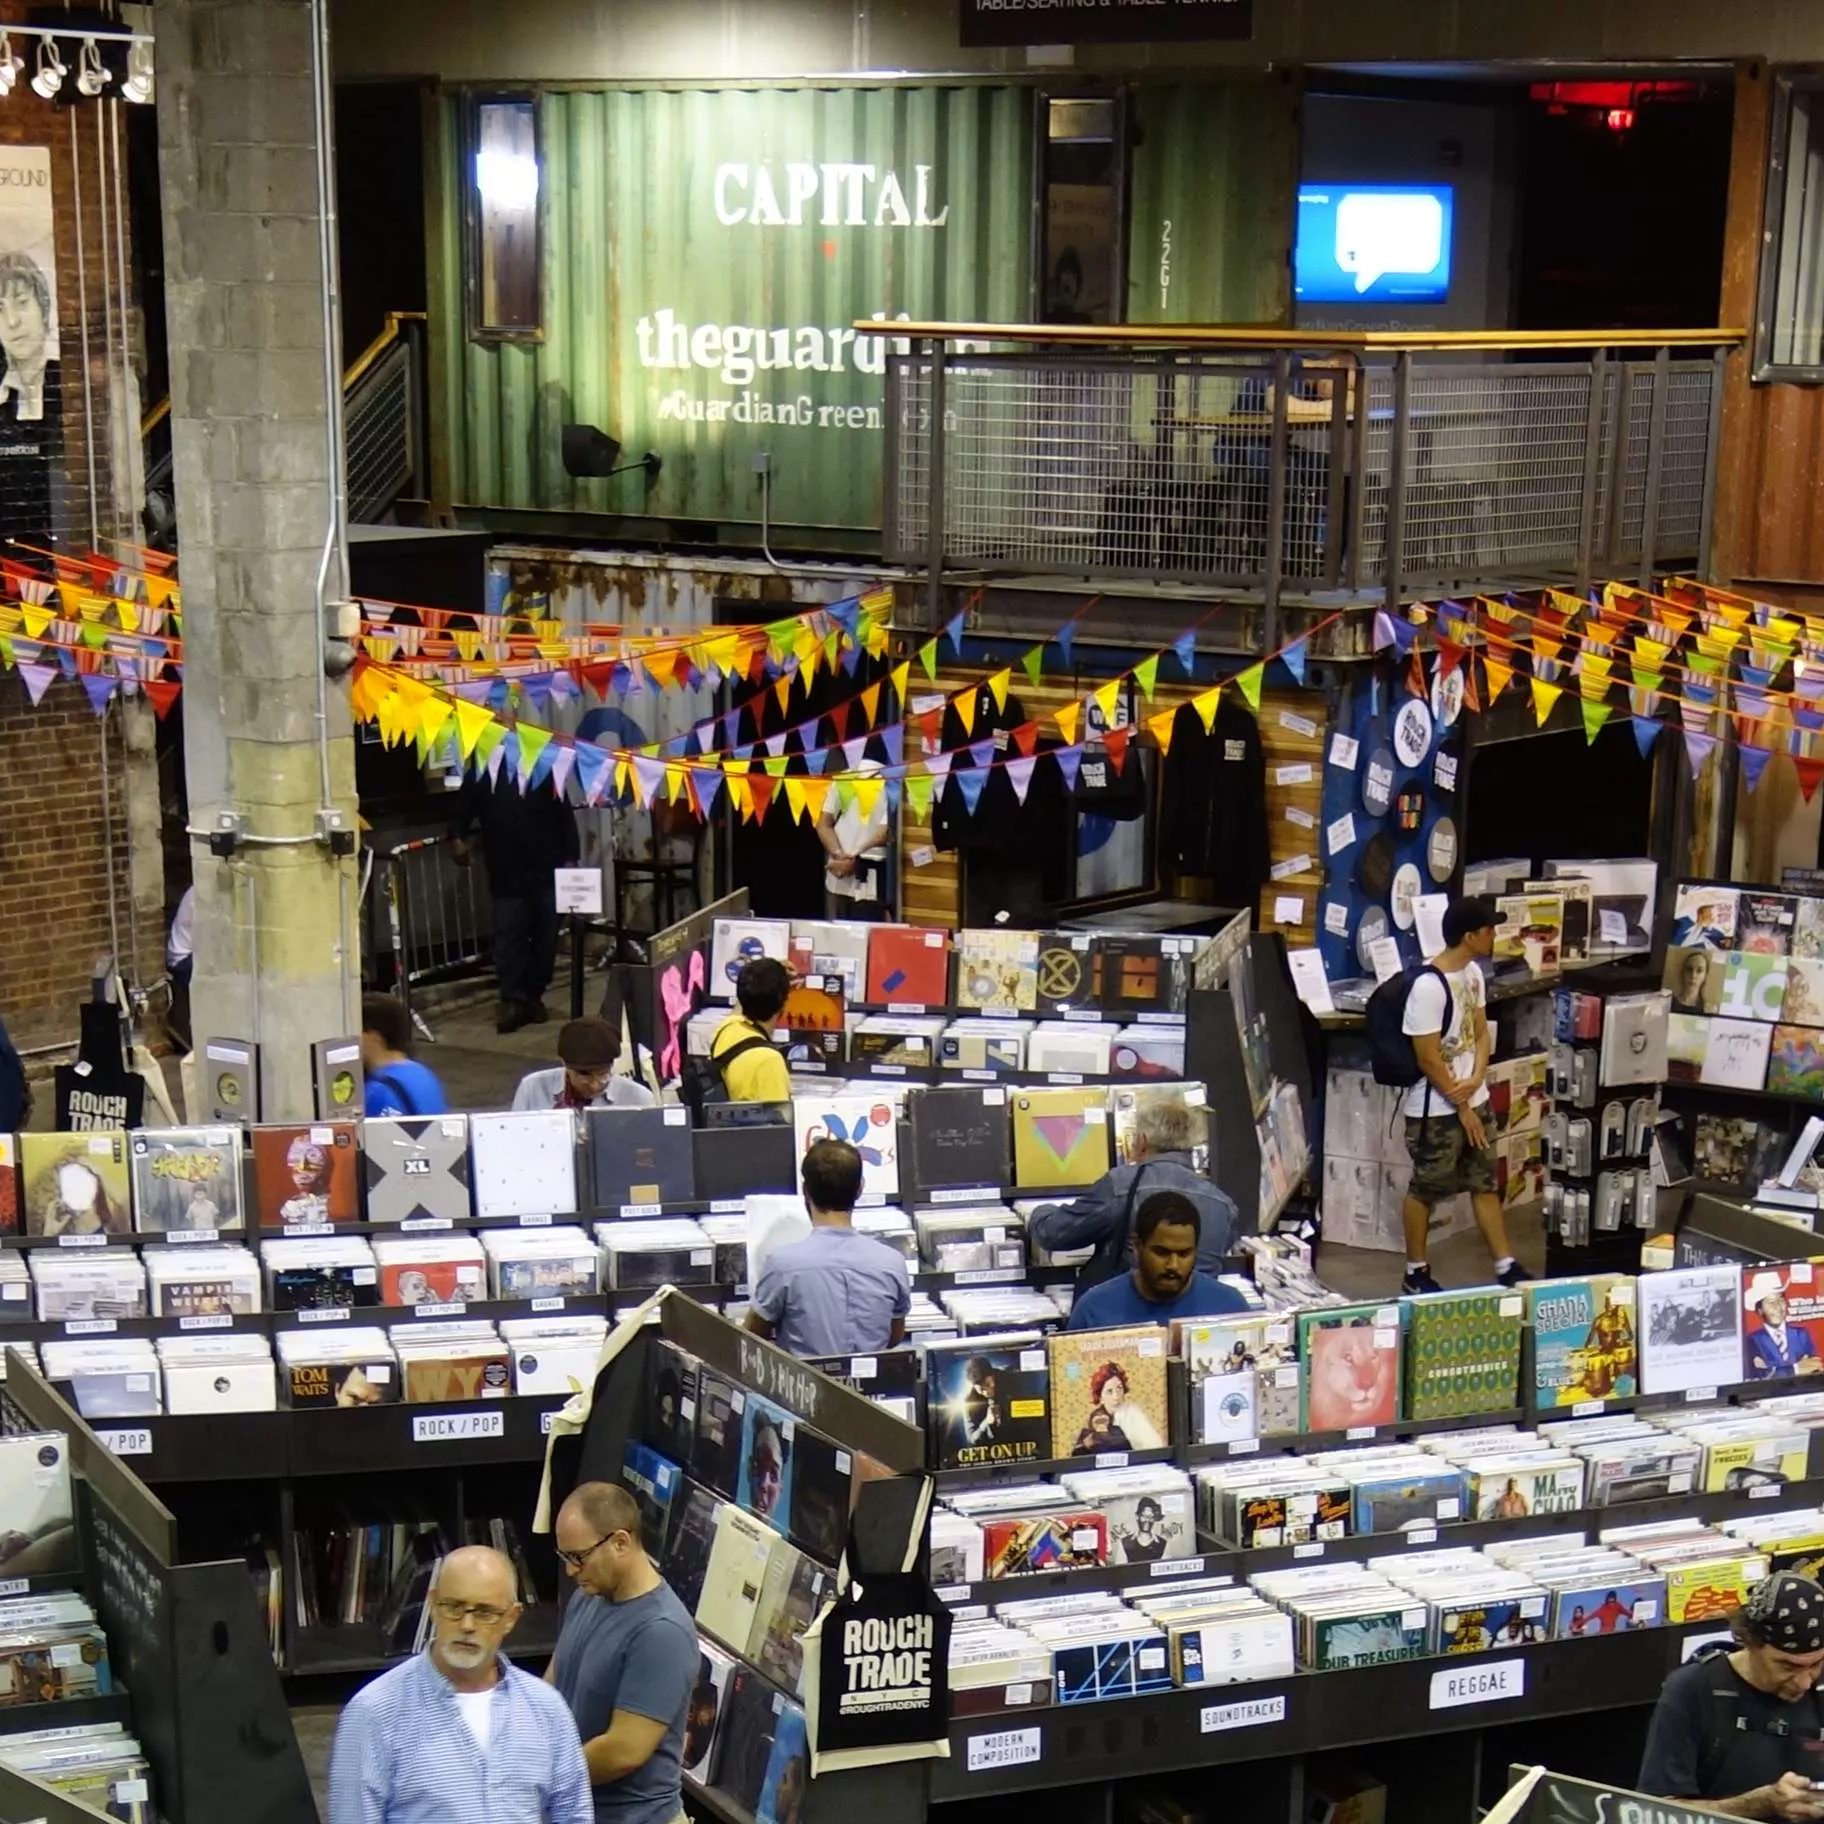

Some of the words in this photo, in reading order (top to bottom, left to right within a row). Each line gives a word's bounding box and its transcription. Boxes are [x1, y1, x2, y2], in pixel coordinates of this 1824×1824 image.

[714, 161, 949, 227] CAPITAL
[69, 1090, 127, 1117] ROUGH
[292, 1367, 329, 1383] TOM
[291, 1382, 329, 1396] WAITS
[418, 1421, 456, 1437] ROCK
[472, 1415, 500, 1432] POP
[118, 1434, 148, 1449] POP
[957, 1445, 990, 1463] GET
[992, 1444, 1013, 1459] ON
[1016, 1441, 1037, 1456] UP
[842, 1616, 933, 1656] ROUGH
[845, 1652, 933, 1692] TRADE
[1448, 1672, 1509, 1697] REGGAE
[1204, 1699, 1283, 1727] SOUNDTRACKS
[984, 1733, 1025, 1749] MODERN
[970, 1745, 1038, 1766] COMPOSITION
